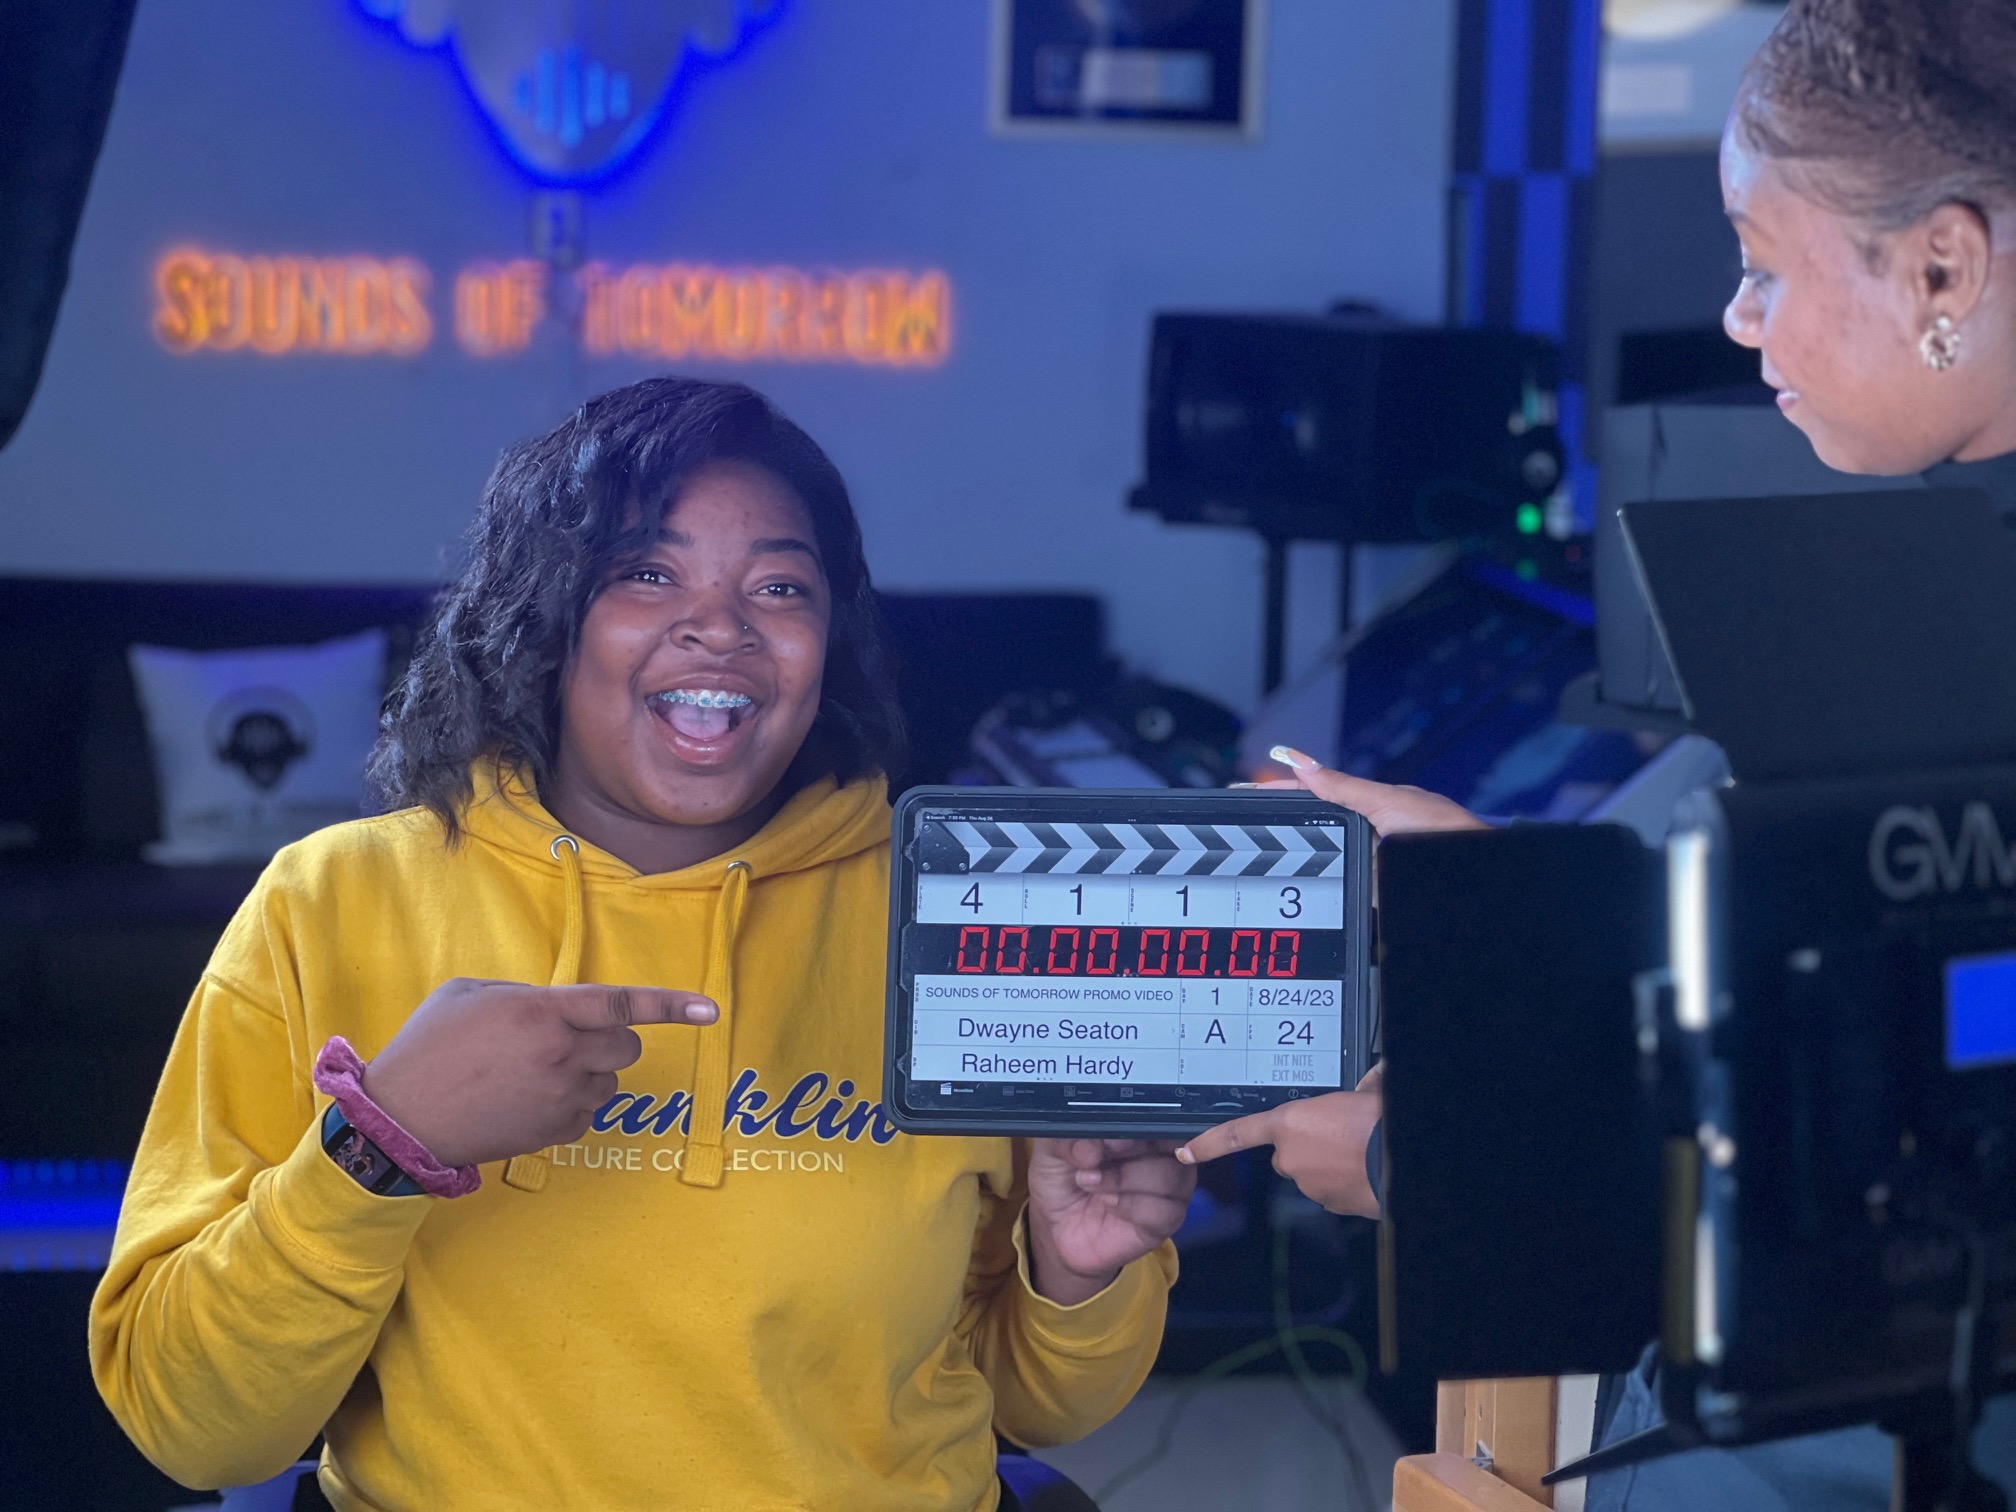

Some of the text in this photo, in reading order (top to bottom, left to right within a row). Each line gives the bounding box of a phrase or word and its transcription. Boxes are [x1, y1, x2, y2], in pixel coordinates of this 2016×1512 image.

[155, 247, 949, 365] SOUNDS OF TOMORROW
[960, 882, 984, 914] 4
[1069, 883, 1083, 916] 1
[1175, 885, 1189, 917] 1
[1279, 886, 1302, 919] 3
[926, 986, 1174, 1001] SOUNDS OF TOMORROW PROMO VIDEO
[1211, 987, 1219, 1006] 1
[1258, 987, 1334, 1007] 8/24/23
[958, 1017, 1138, 1043] Dwayne Seaton
[1204, 1018, 1227, 1044] A
[1277, 1020, 1315, 1045] 24
[961, 1053, 1134, 1080] Raheem Hardy
[1273, 1053, 1314, 1067] INT NITE
[1272, 1069, 1315, 1083] EXT MOS
[589, 1067, 899, 1146] anklin
[552, 1143, 844, 1173] LTURE CECTION
